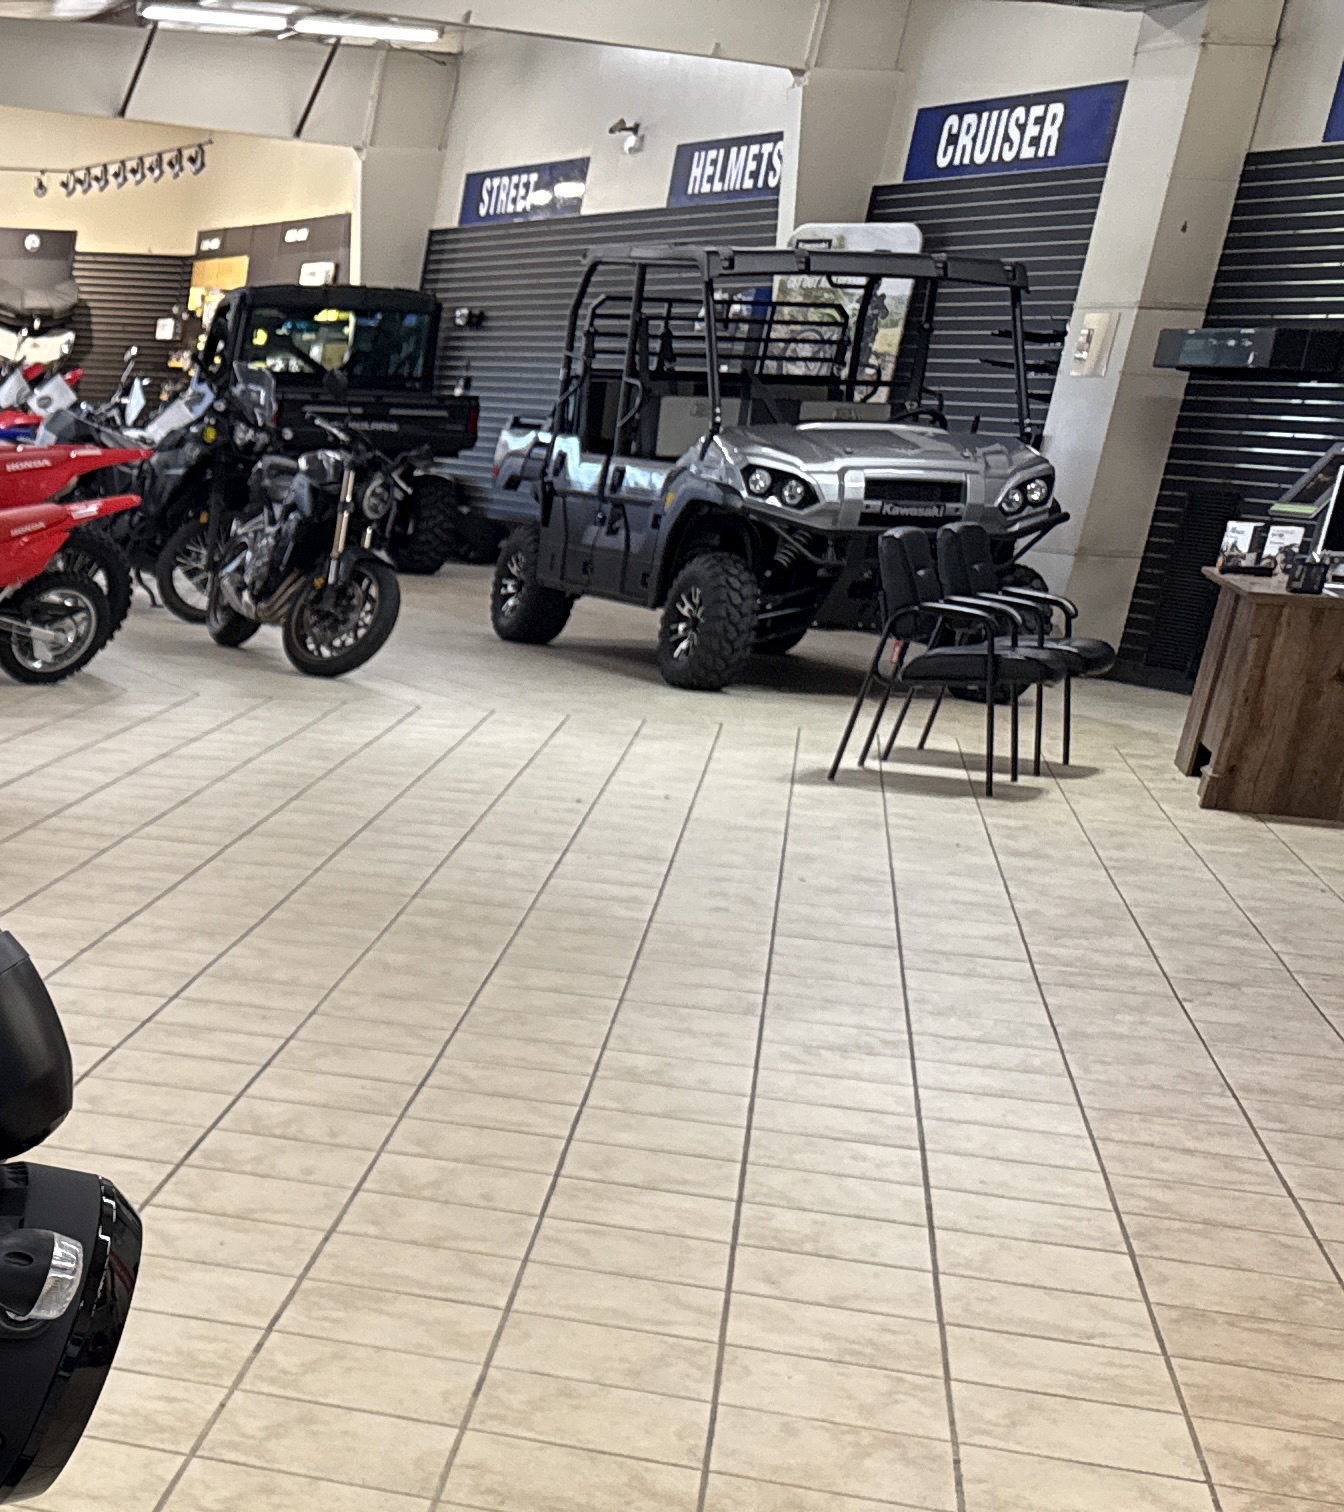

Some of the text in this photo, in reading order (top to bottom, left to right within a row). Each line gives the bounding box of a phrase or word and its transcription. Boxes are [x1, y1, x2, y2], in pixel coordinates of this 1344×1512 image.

[936, 103, 1064, 168] CRUISER
[687, 140, 782, 195] HELMETS
[478, 172, 539, 217] STREET
[5, 459, 52, 472] HONDA
[882, 503, 944, 518] Kawasaki
[10, 521, 45, 537] HONDA
